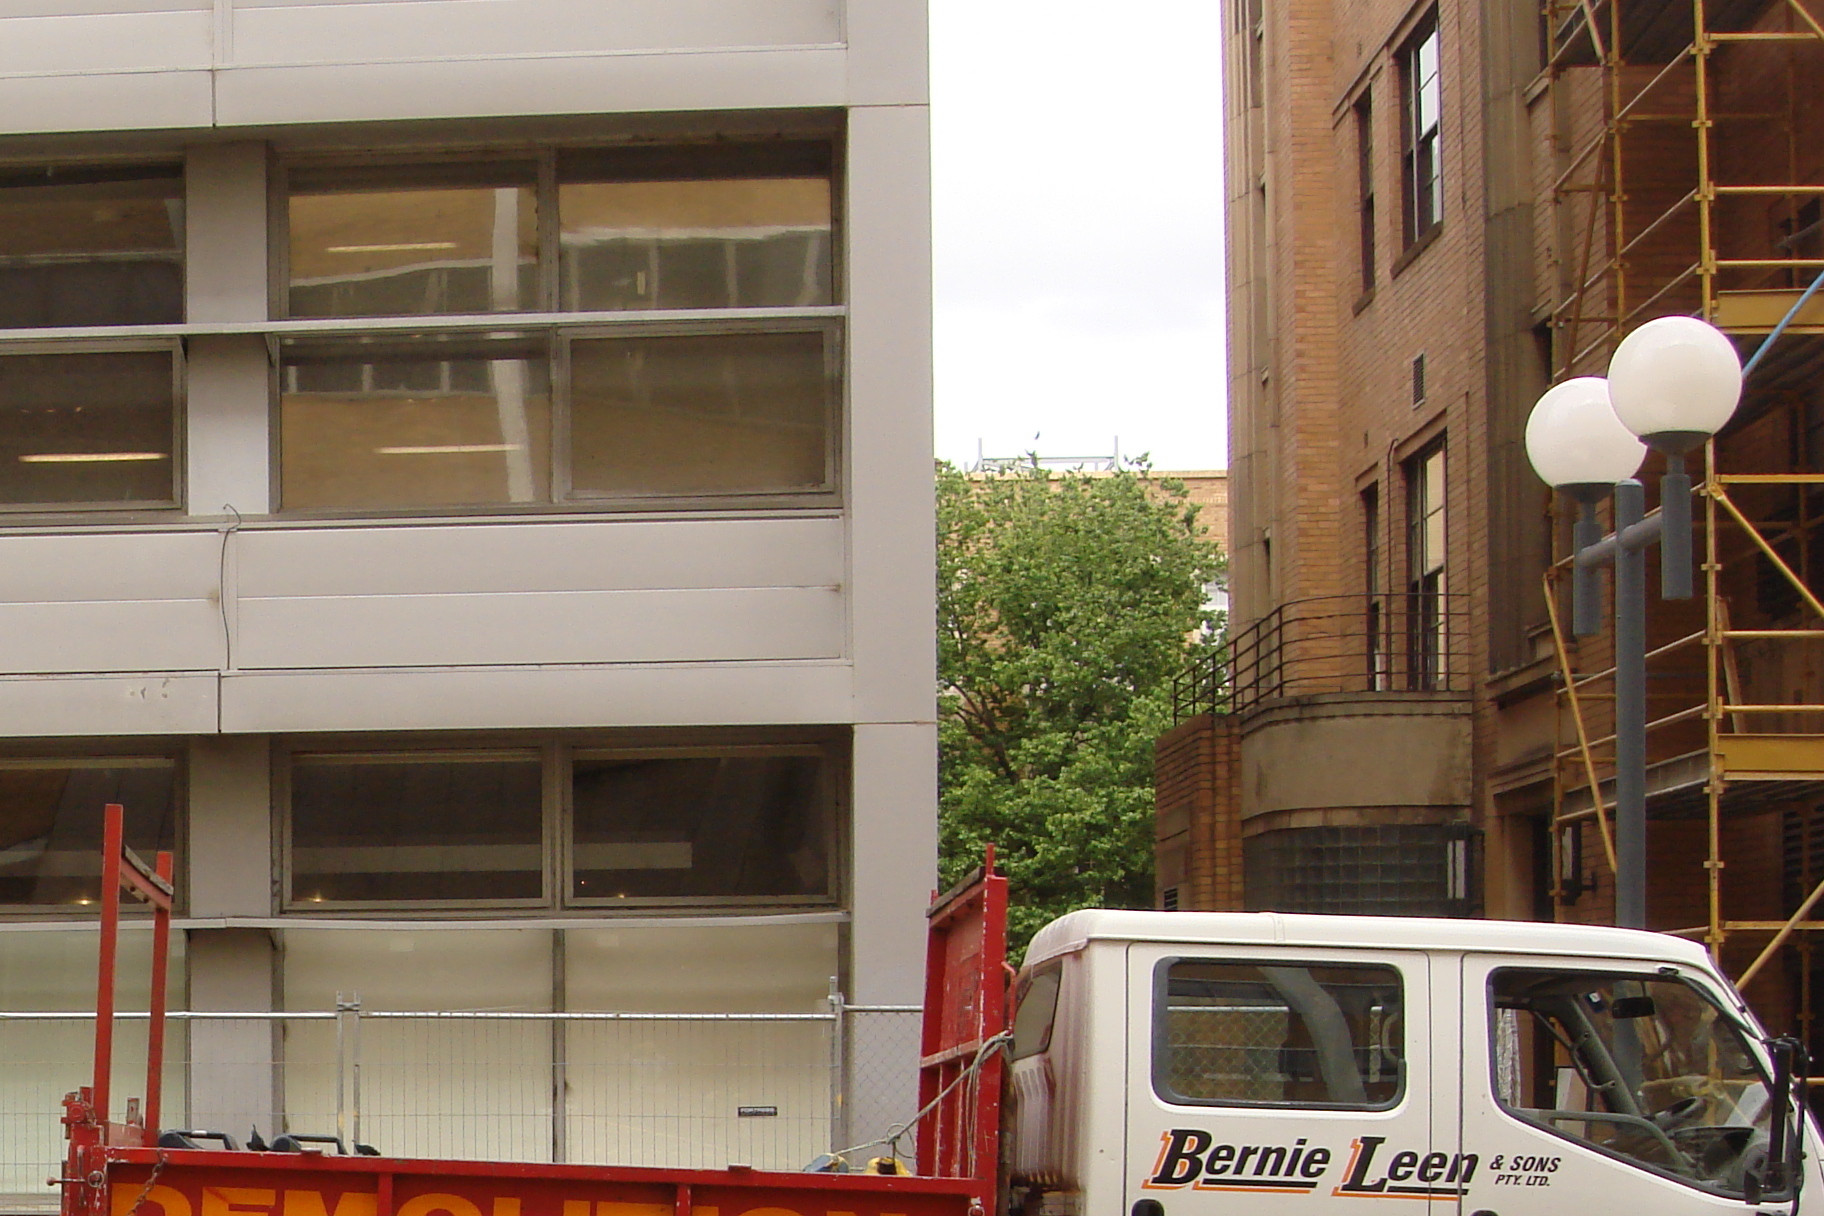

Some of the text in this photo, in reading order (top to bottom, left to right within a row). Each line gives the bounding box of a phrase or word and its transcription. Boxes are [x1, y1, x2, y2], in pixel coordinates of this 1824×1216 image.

[1148, 1128, 1561, 1193] Bernie Leen & SONS
[1495, 1174, 1551, 1187] PTY. LTD.
